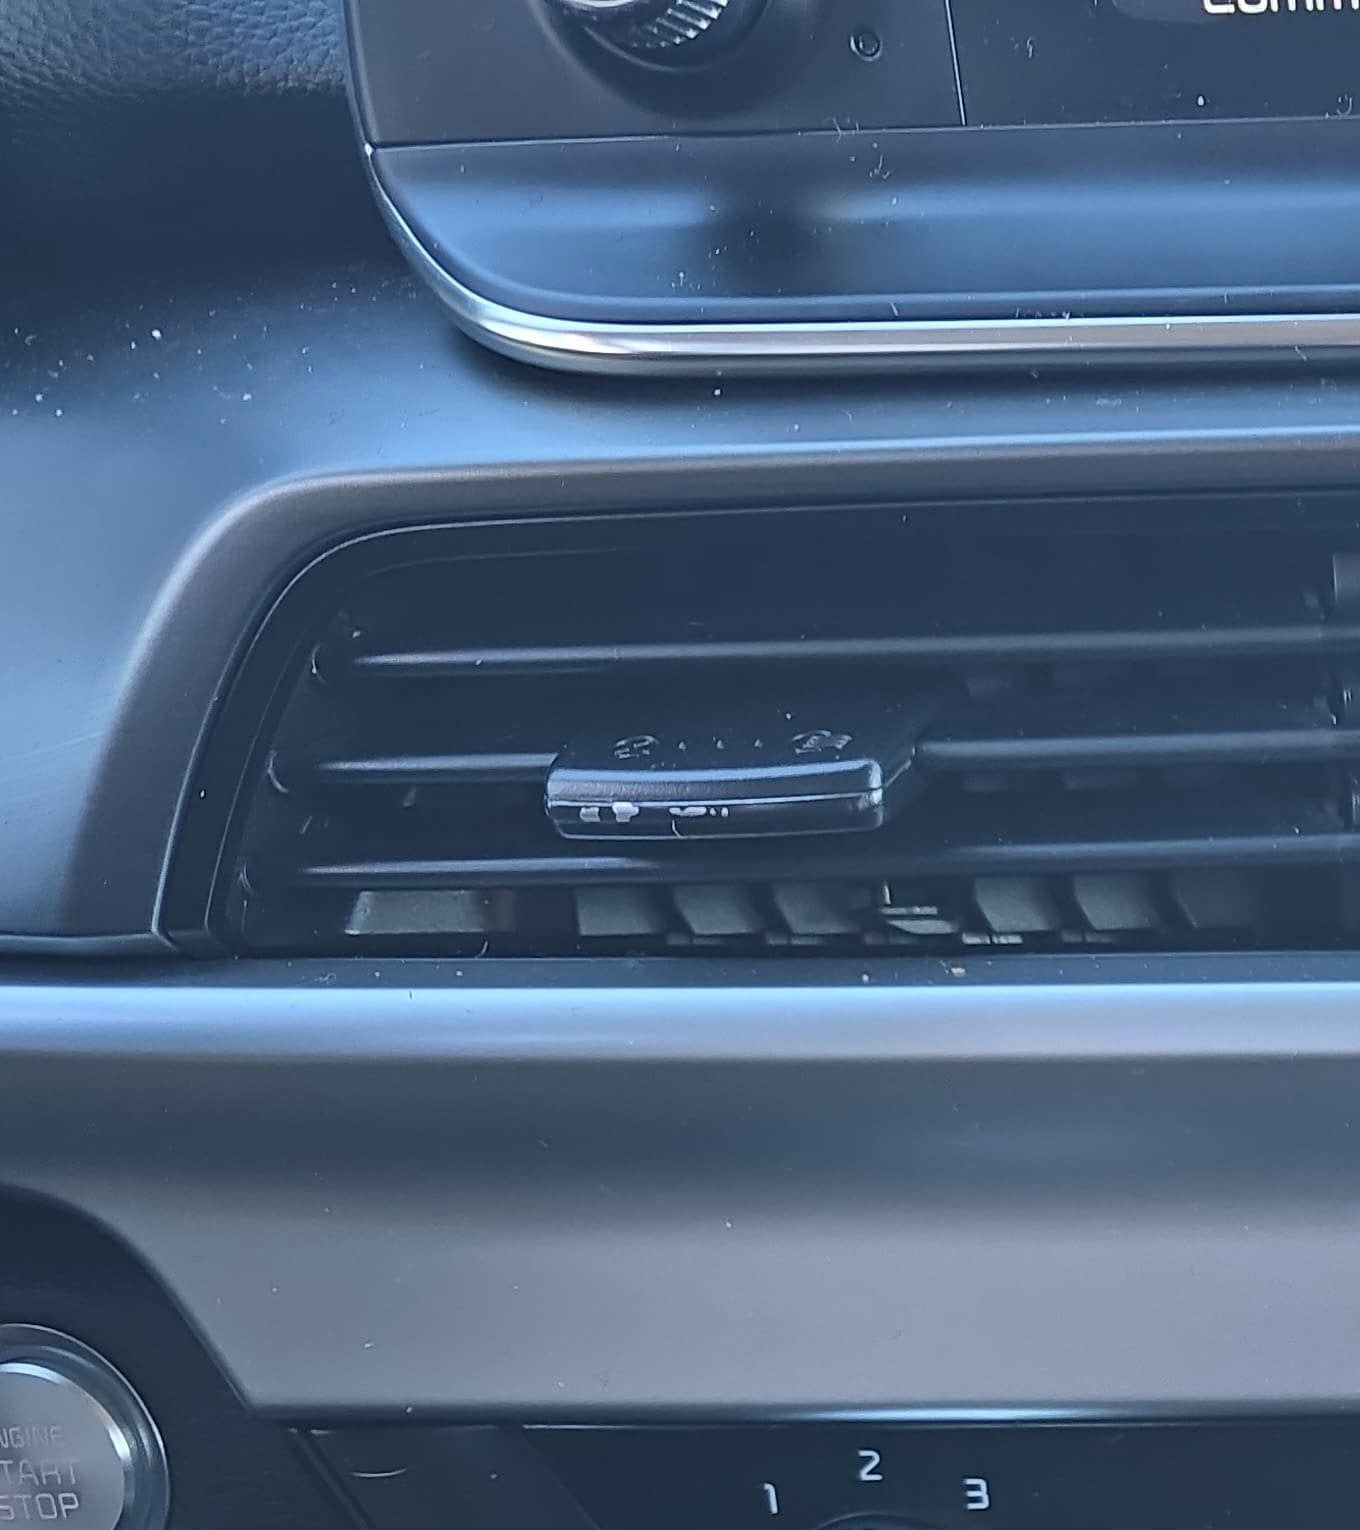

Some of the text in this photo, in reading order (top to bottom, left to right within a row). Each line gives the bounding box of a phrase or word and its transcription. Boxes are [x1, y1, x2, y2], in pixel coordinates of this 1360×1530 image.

[0, 1459, 80, 1486] TART
[858, 1450, 883, 1482] 2
[763, 1482, 780, 1514] 1
[962, 1478, 990, 1510] 3
